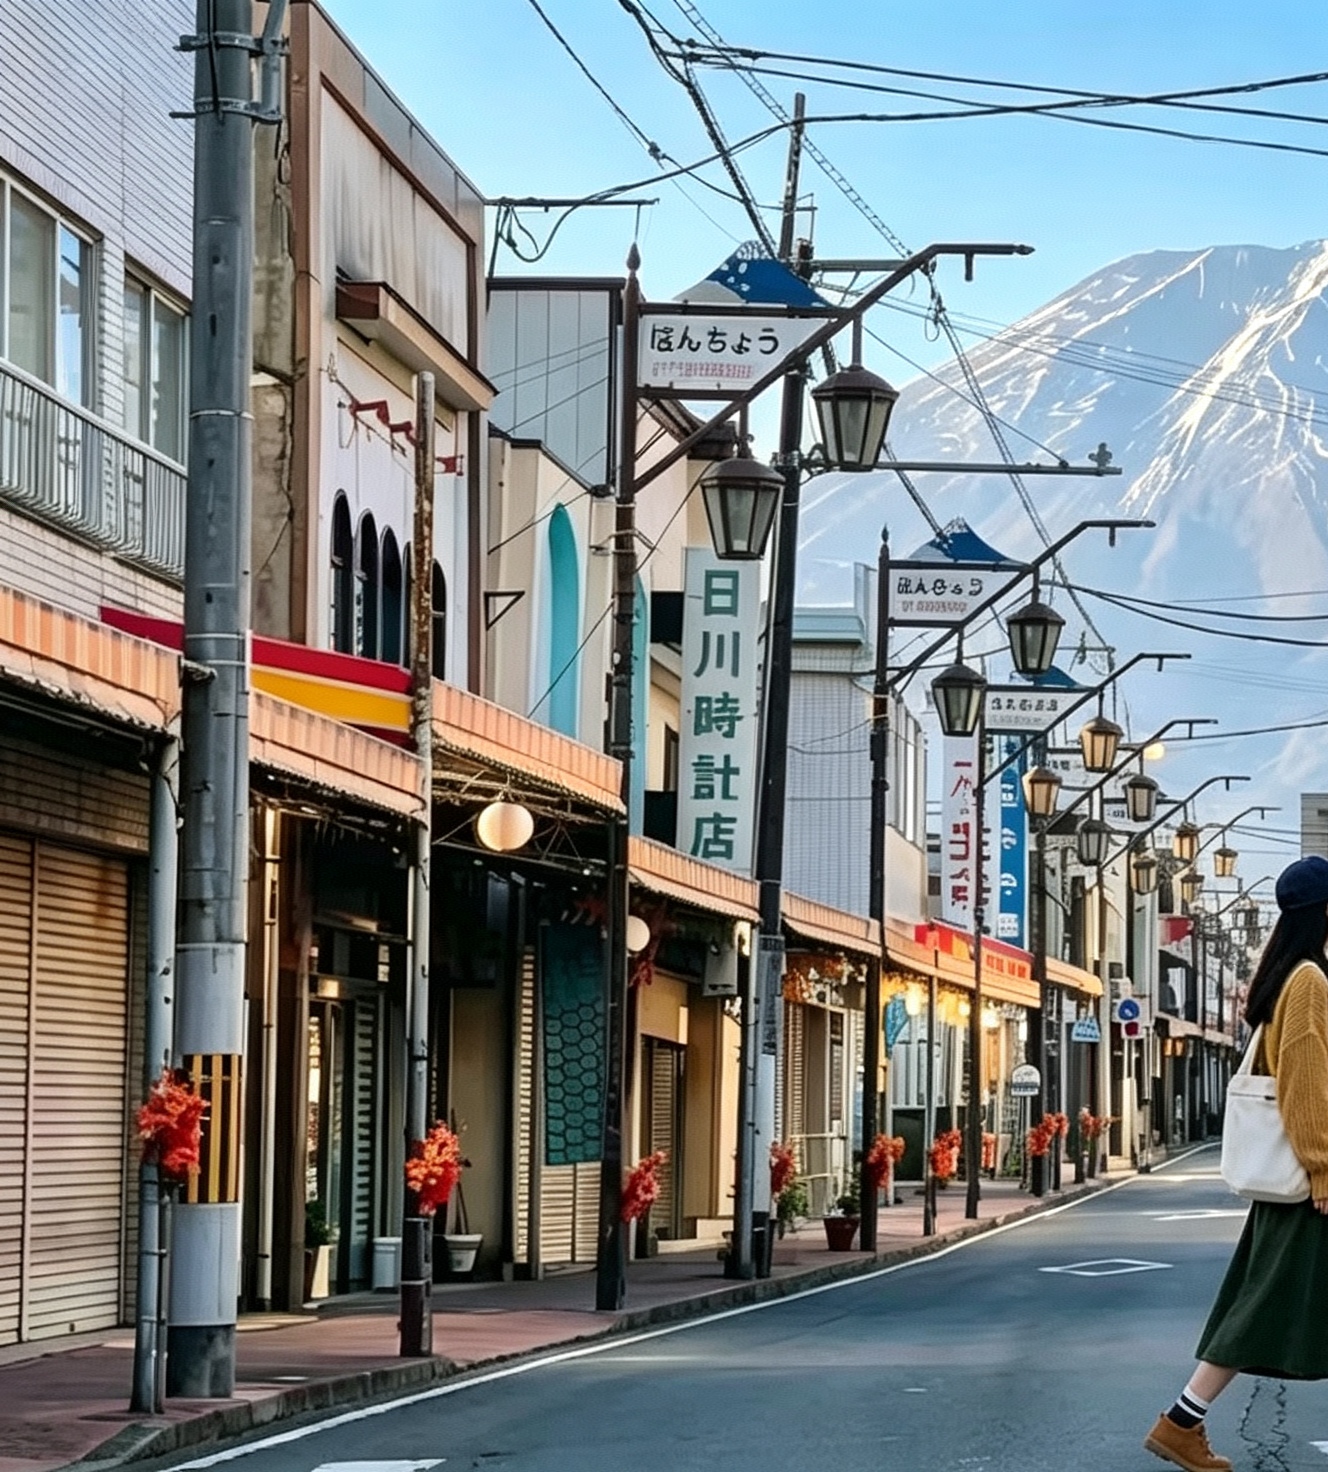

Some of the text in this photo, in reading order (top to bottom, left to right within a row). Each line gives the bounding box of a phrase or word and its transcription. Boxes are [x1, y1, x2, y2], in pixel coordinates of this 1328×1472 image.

[689, 570, 744, 860] 日川時計店
